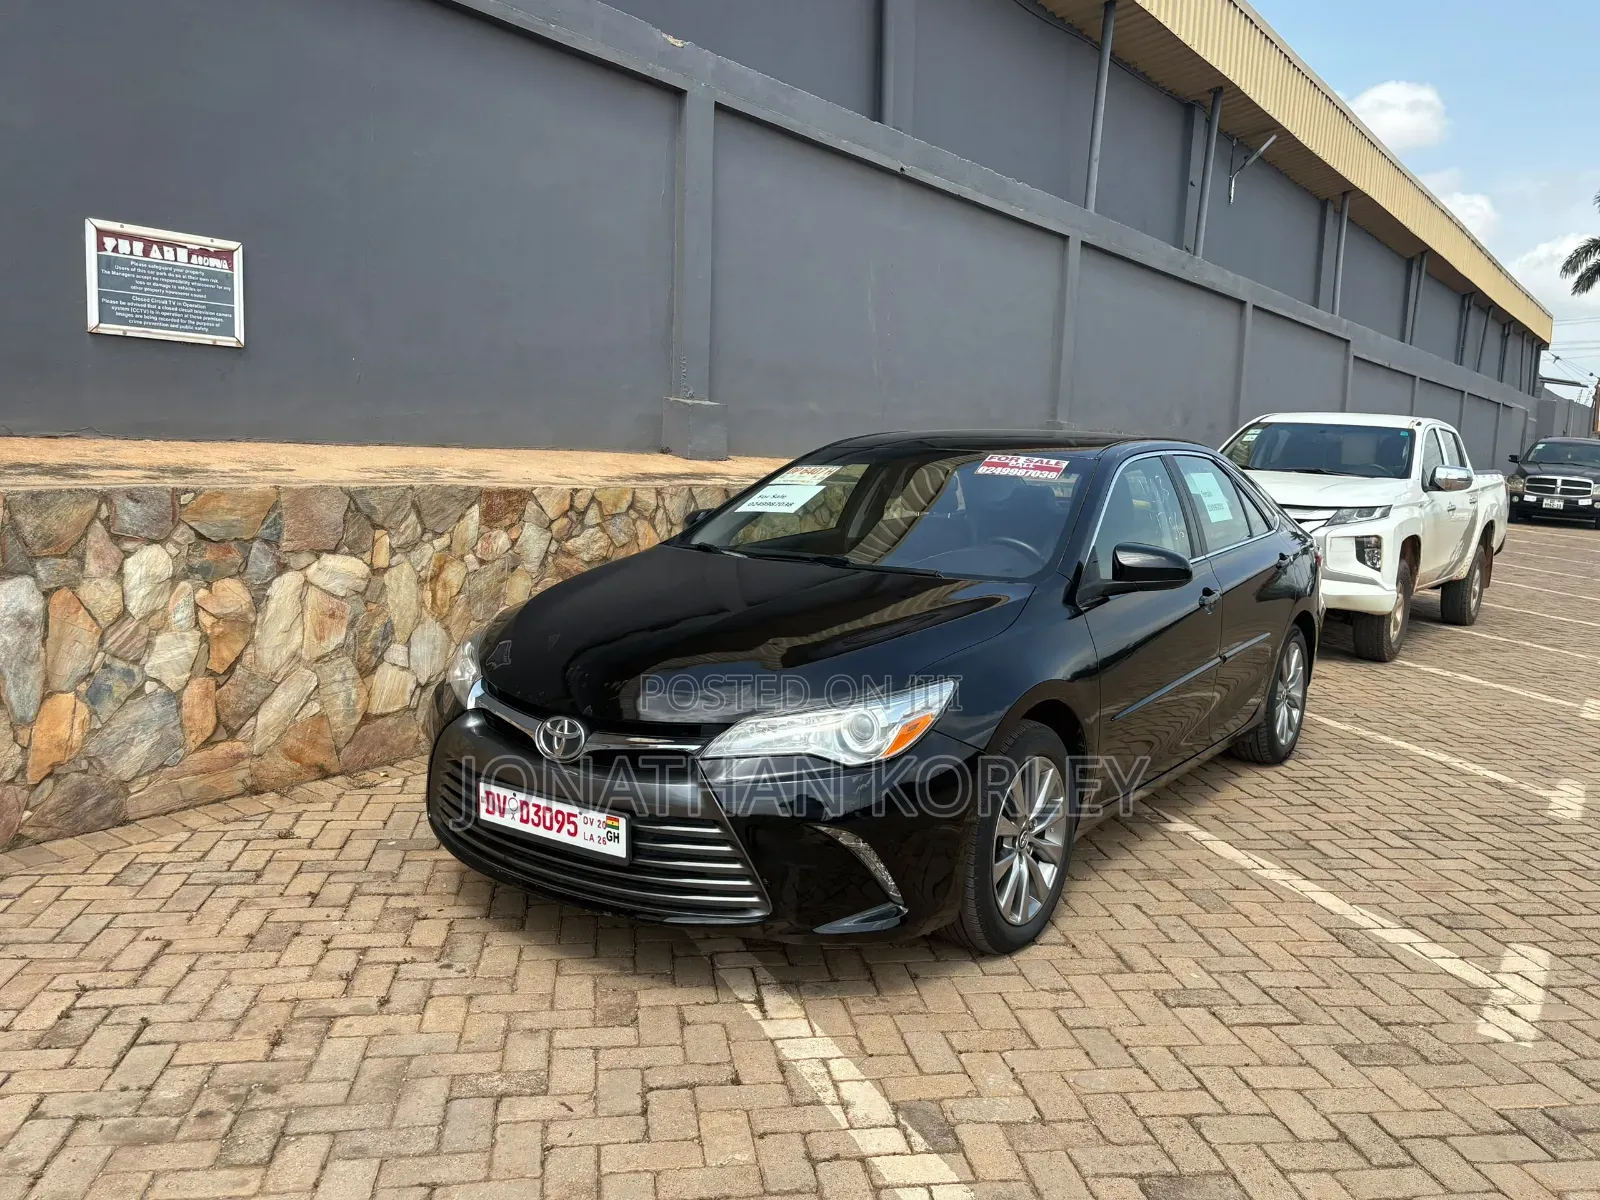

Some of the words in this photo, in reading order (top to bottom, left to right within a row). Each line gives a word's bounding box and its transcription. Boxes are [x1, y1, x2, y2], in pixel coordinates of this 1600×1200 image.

[1024, 456, 1066, 466] SALE
[977, 466, 1058, 479] 0249987038
[485, 790, 507, 818] DV
[519, 800, 578, 838] D3095
[583, 816, 594, 826] DV
[597, 819, 607, 830] 20
[584, 832, 594, 843] LA
[598, 834, 607, 846] 26
[606, 830, 620, 844] GH
